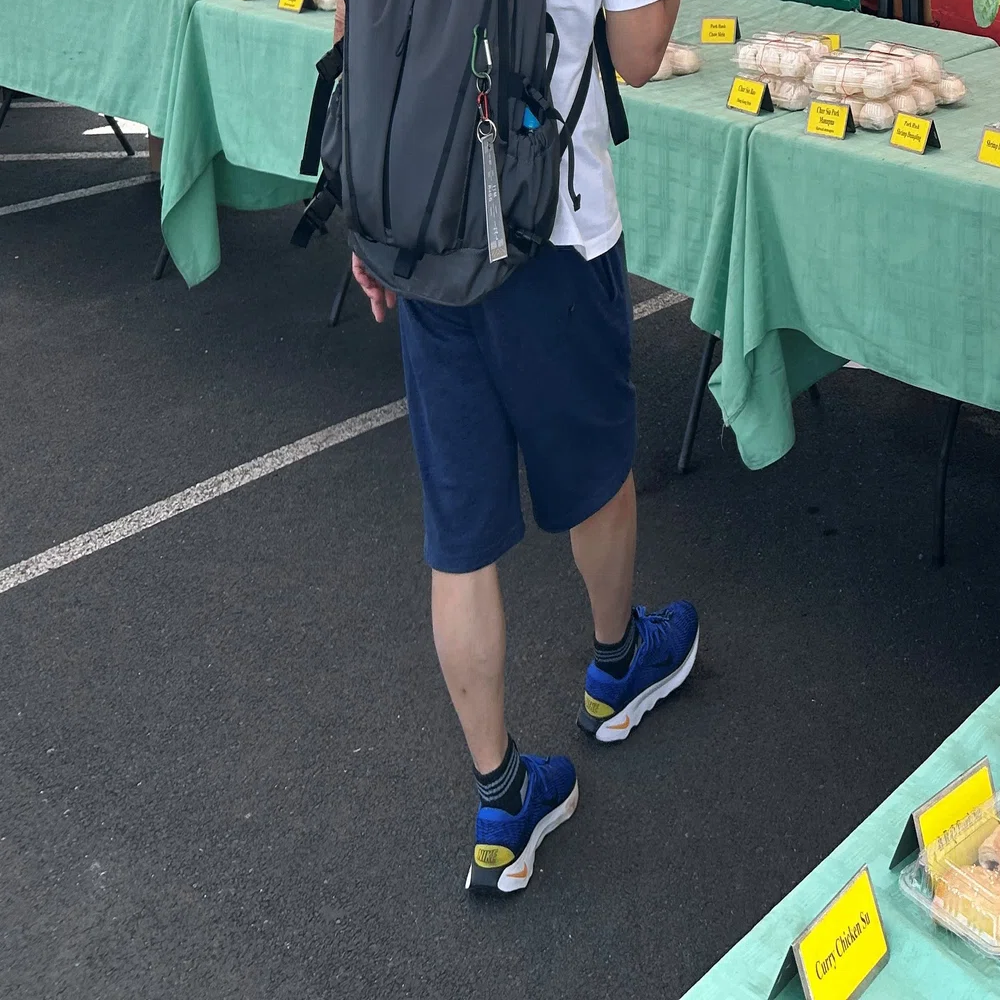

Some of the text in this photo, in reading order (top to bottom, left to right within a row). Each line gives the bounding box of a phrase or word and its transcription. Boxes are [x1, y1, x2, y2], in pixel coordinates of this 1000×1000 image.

[477, 849, 499, 864] NIKE
[815, 911, 871, 980] Curry Chicken Su
